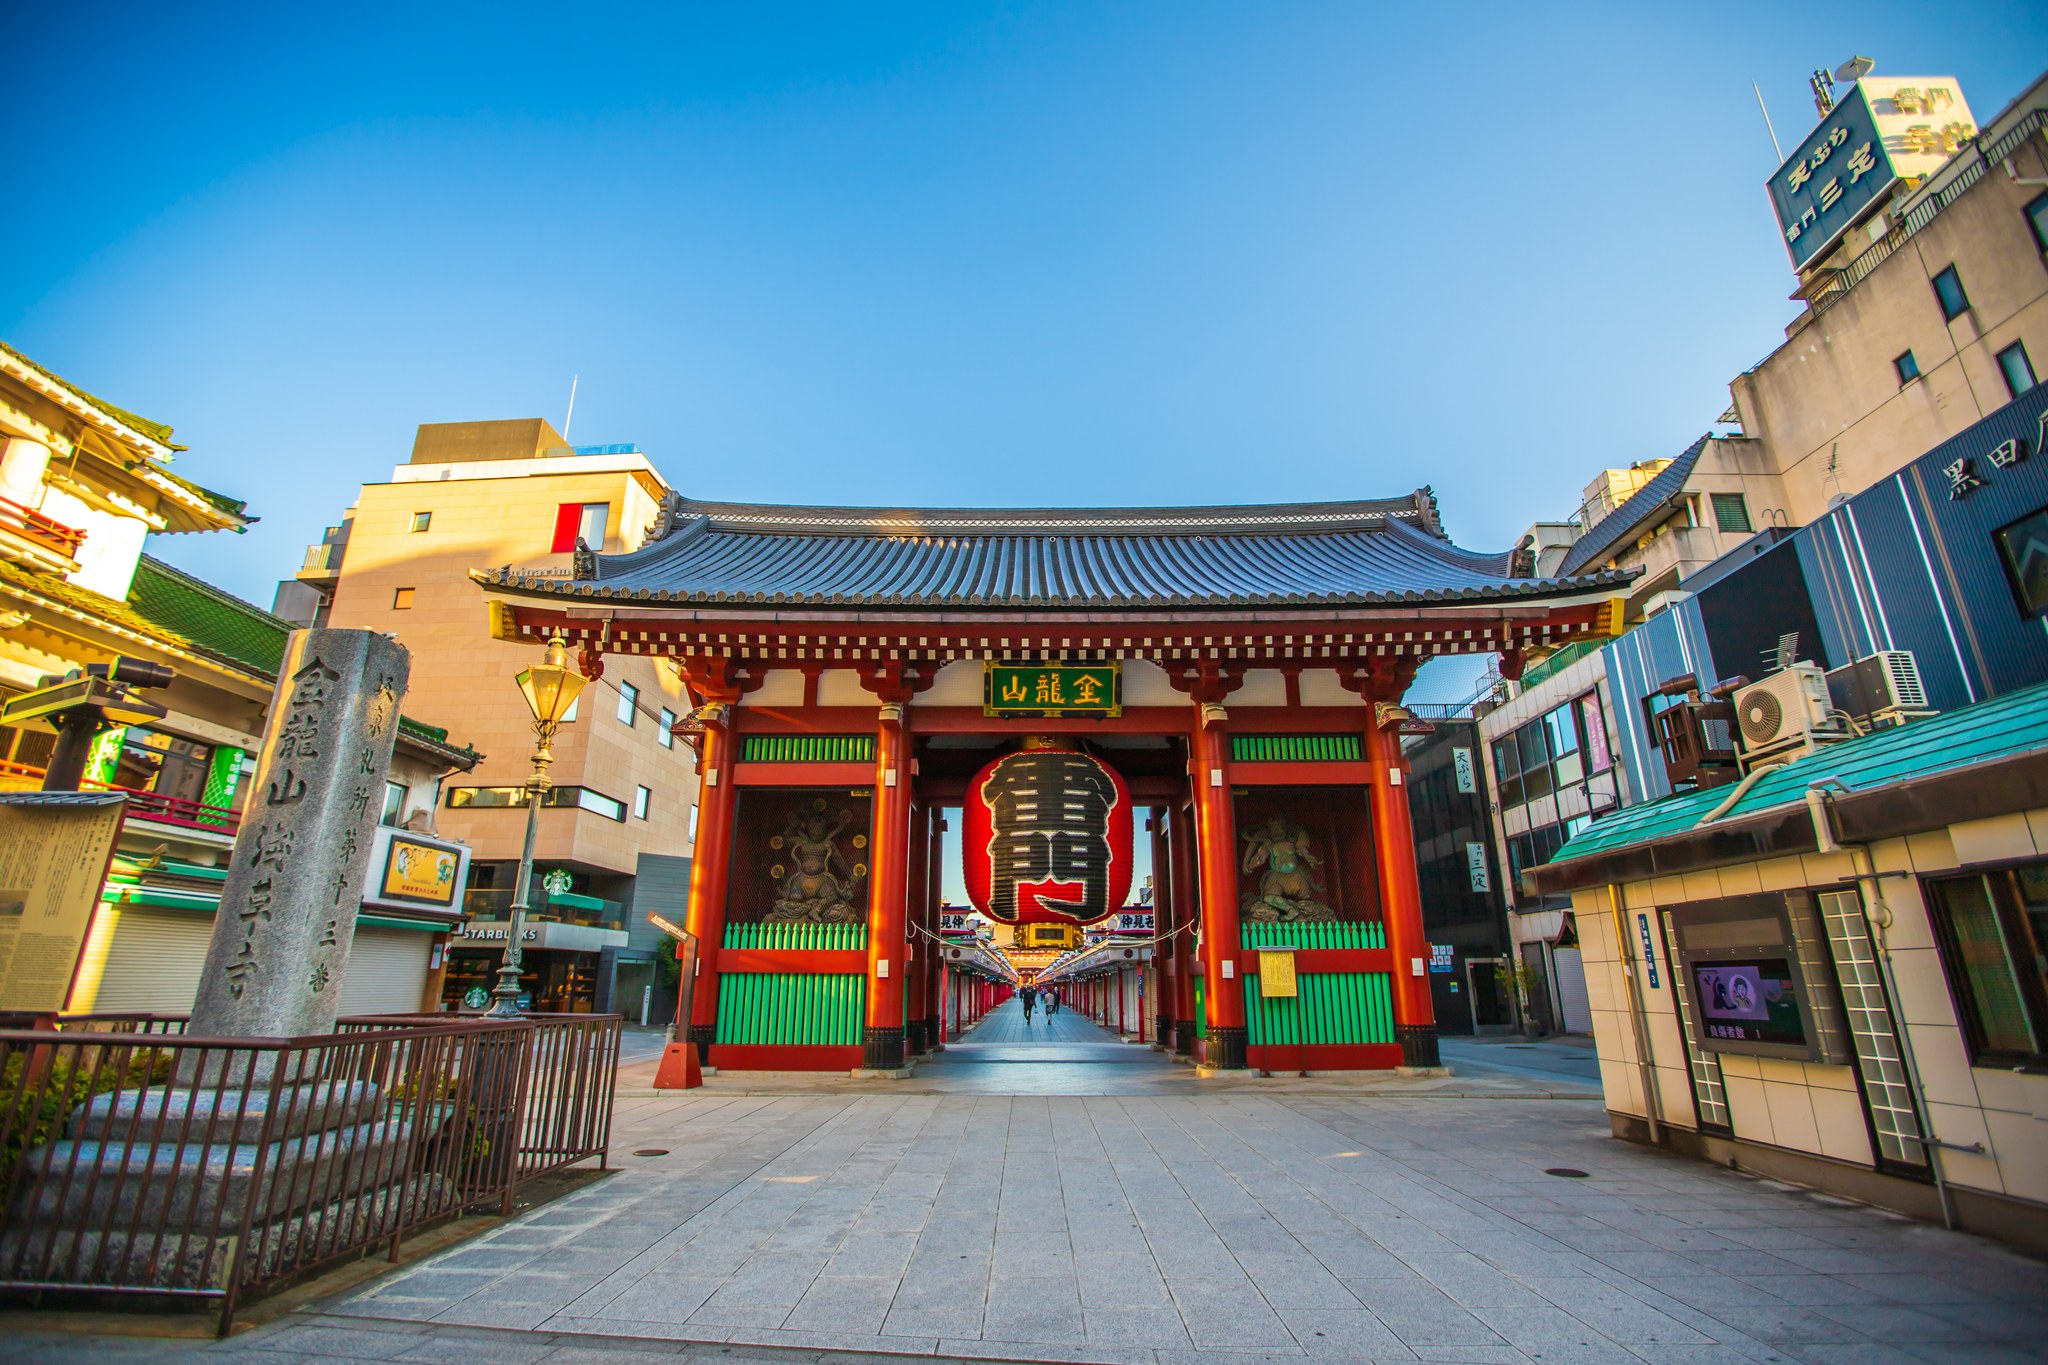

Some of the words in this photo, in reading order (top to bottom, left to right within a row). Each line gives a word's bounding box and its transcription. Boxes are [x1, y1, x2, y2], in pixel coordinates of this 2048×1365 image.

[1788, 127, 1849, 194] 天ぷら
[981, 751, 1118, 922] 雷門
[463, 929, 537, 940] STARBUKS
